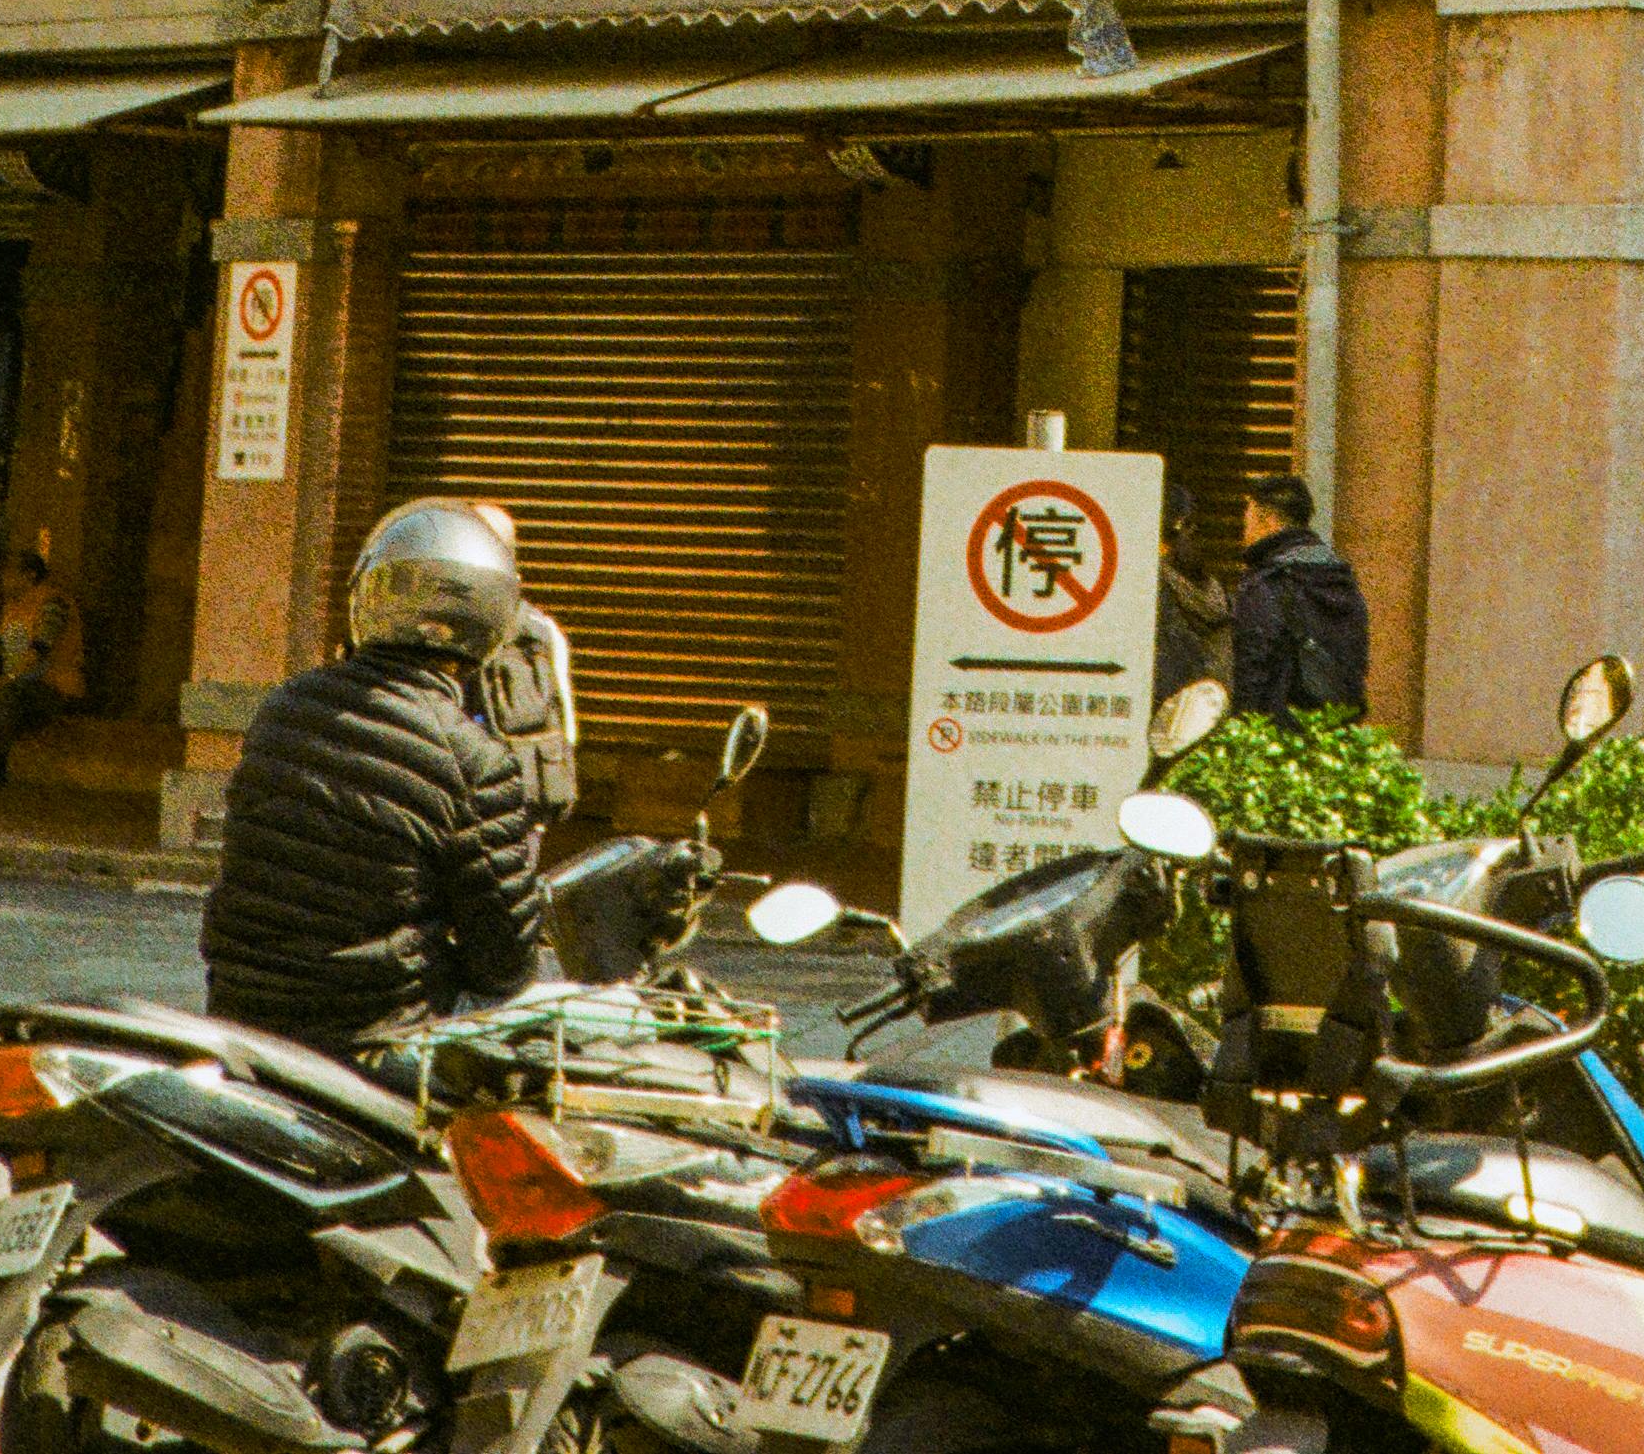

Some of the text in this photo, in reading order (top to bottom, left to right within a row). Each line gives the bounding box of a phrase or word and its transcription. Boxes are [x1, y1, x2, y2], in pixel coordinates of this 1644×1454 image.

[995, 505, 1086, 598] 停
[972, 779, 1099, 812] 禁止停車
